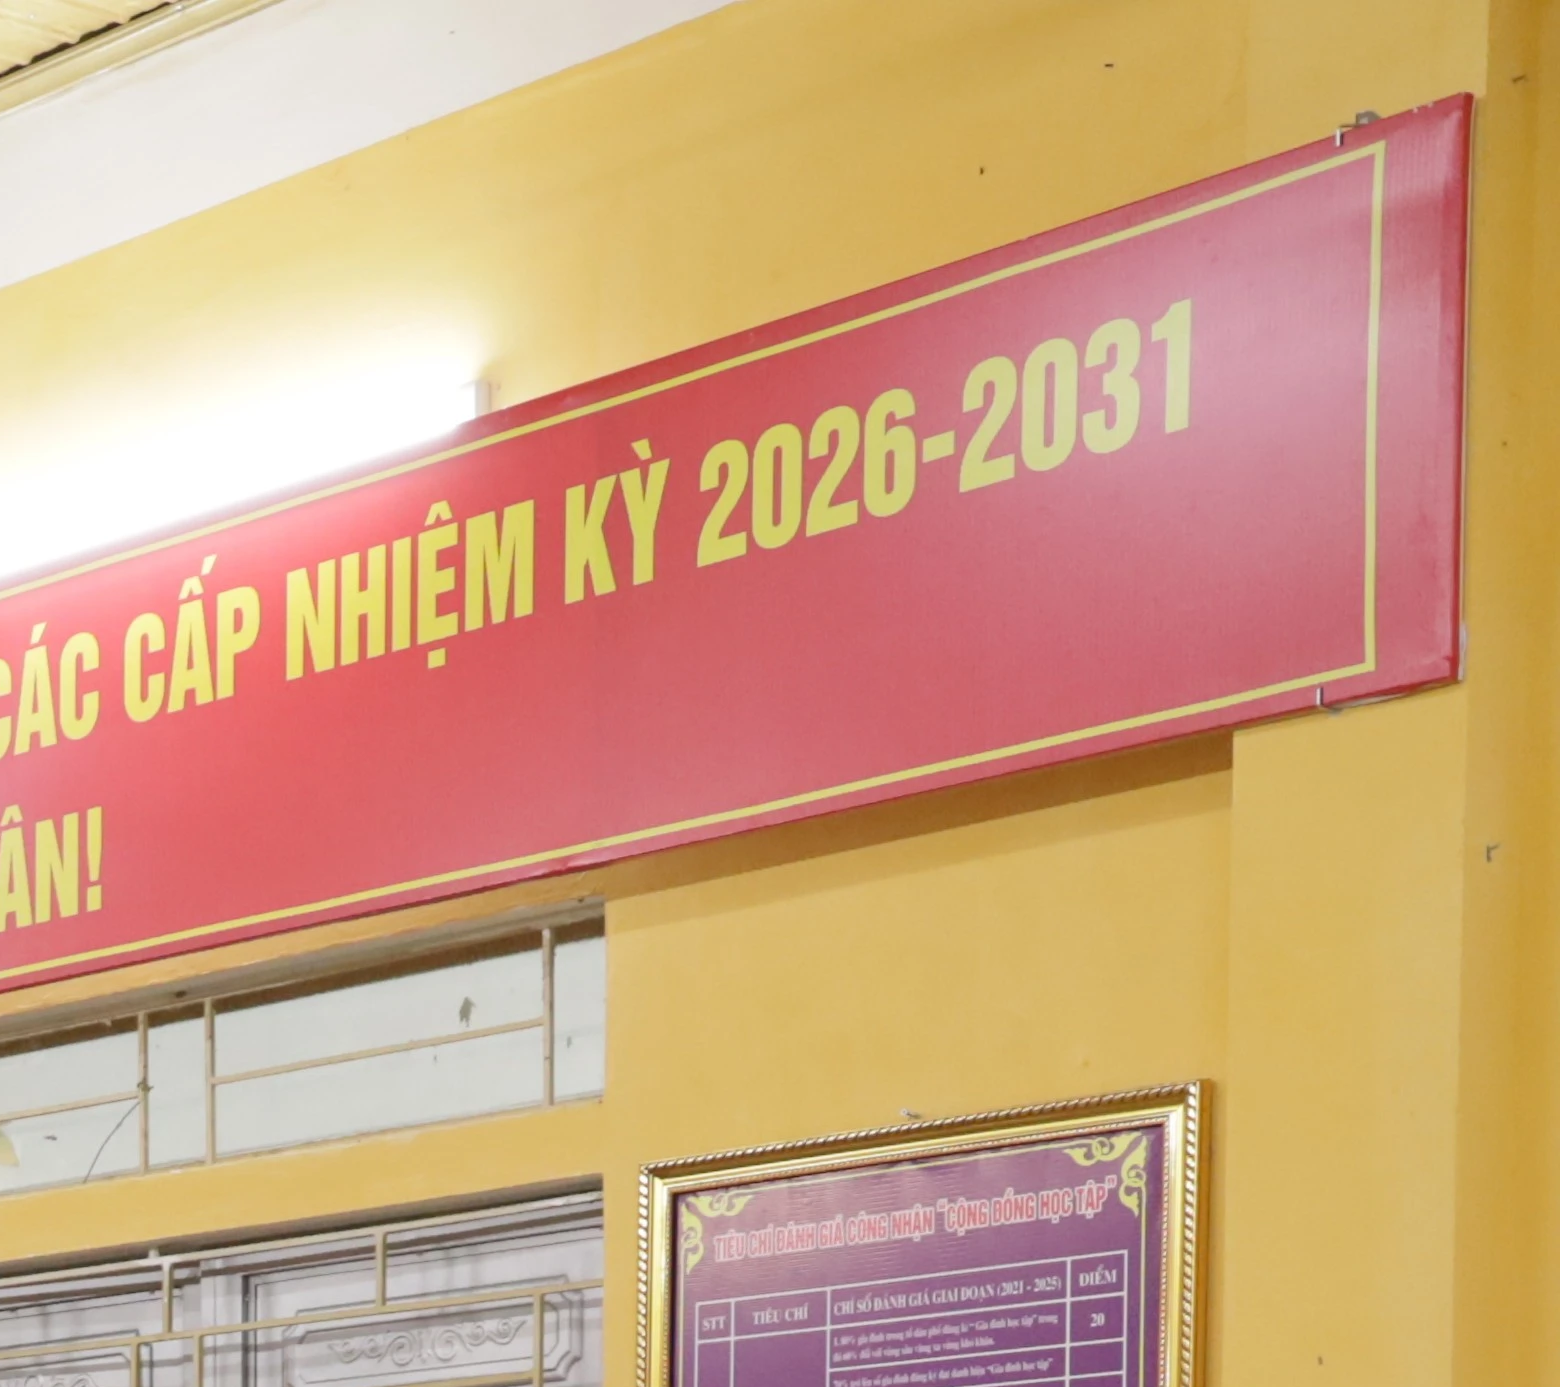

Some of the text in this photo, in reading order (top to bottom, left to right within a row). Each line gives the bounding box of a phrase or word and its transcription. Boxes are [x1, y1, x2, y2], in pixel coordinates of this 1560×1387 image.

[123, 555, 260, 723] CẤP
[285, 500, 535, 681] NHIỆM
[564, 439, 671, 605] KỲ
[697, 298, 1192, 568] 2026-2031
[713, 1229, 746, 1262] TIÊU
[747, 1223, 774, 1258] CHÍ
[775, 1220, 816, 1254] ĐÁNH
[819, 1214, 844, 1248] GIÁ
[846, 1210, 888, 1245] CÔNG
[890, 1203, 935, 1242] NHẬN
[992, 1187, 1036, 1225] ĐỒNG
[1039, 1188, 1073, 1223] HỌC
[1079, 1265, 1117, 1287] ĐIỂM
[1090, 1313, 1105, 1328] 20
